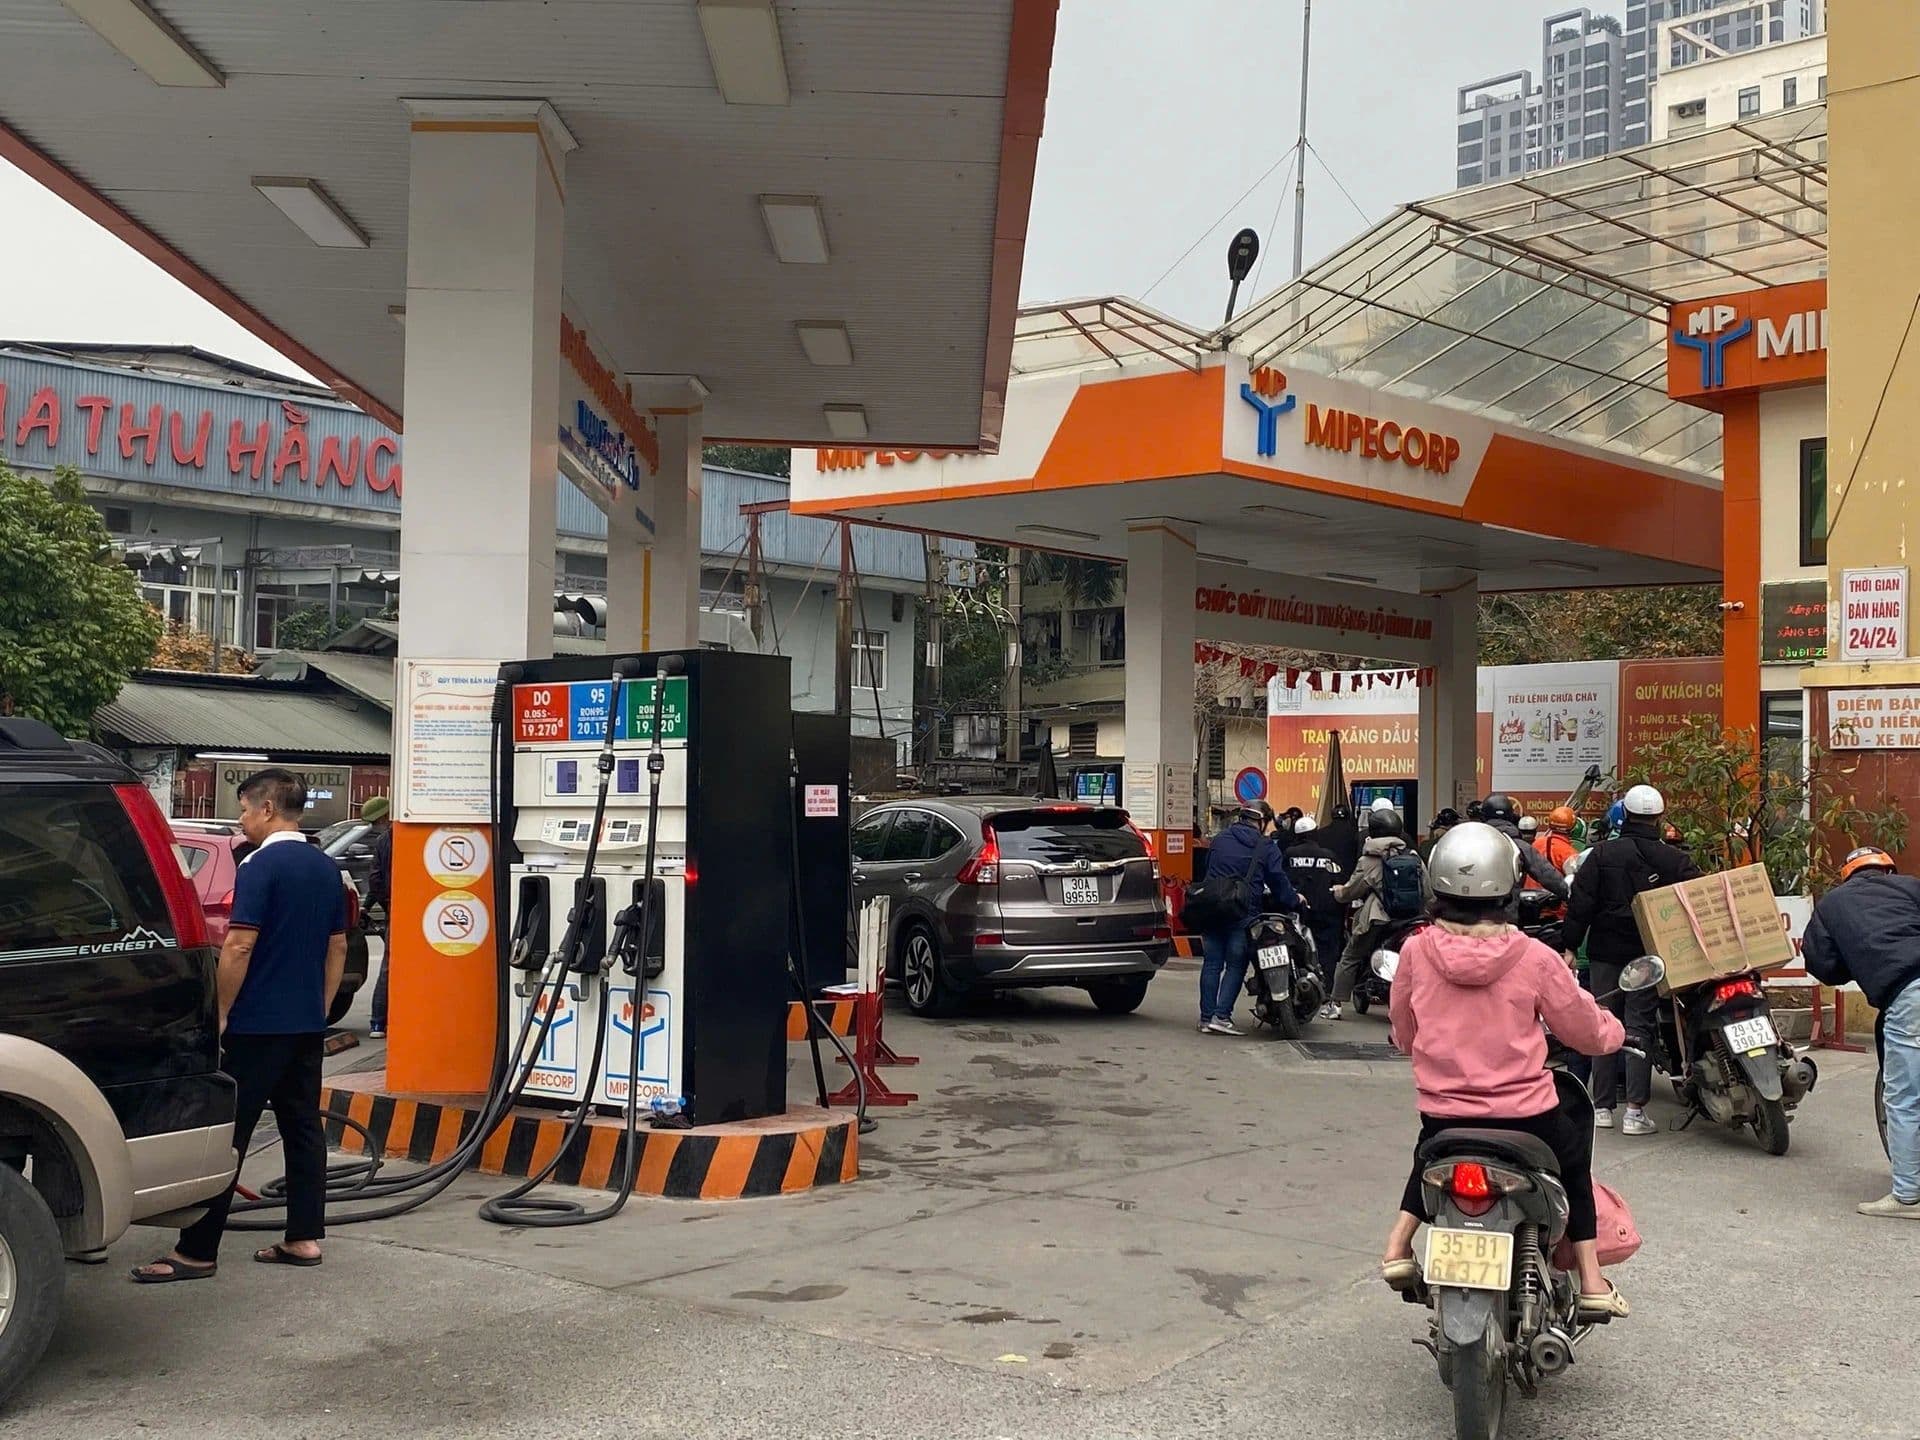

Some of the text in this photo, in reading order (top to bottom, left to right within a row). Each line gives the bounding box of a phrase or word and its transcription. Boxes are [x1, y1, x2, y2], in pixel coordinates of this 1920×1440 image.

[1688, 305, 1736, 336] MP
[1251, 366, 1460, 474] MP MIPECORP
[76, 395, 213, 469] THU
[227, 400, 402, 498] HẰNG
[1849, 577, 1900, 592] THỜI GIAN
[1848, 598, 1900, 619] BÁN HÀNG
[1849, 627, 1897, 649] 24/24
[533, 691, 551, 705] DO
[591, 688, 605, 703] 95
[651, 686, 666, 700] E
[1635, 682, 1659, 699] QUÝ
[1662, 681, 1702, 699] KHÁCH
[1837, 694, 1882, 711] ĐIỂM
[522, 724, 558, 736] 19.270
[577, 722, 608, 734] 20.15
[636, 720, 674, 733] 19.20
[1340, 726, 1379, 744] XĂNG
[1876, 734, 1894, 746] XE
[1275, 752, 1308, 773] QUYẾT
[1312, 756, 1326, 773] TÂ
[1375, 755, 1415, 773] THÀNH
[302, 772, 344, 786] OTEL
[1072, 878, 1089, 890] 30A
[79, 940, 157, 954] EVEREST
[609, 1081, 665, 1098] MIPCORP
[1440, 1233, 1498, 1259] 35-B1
